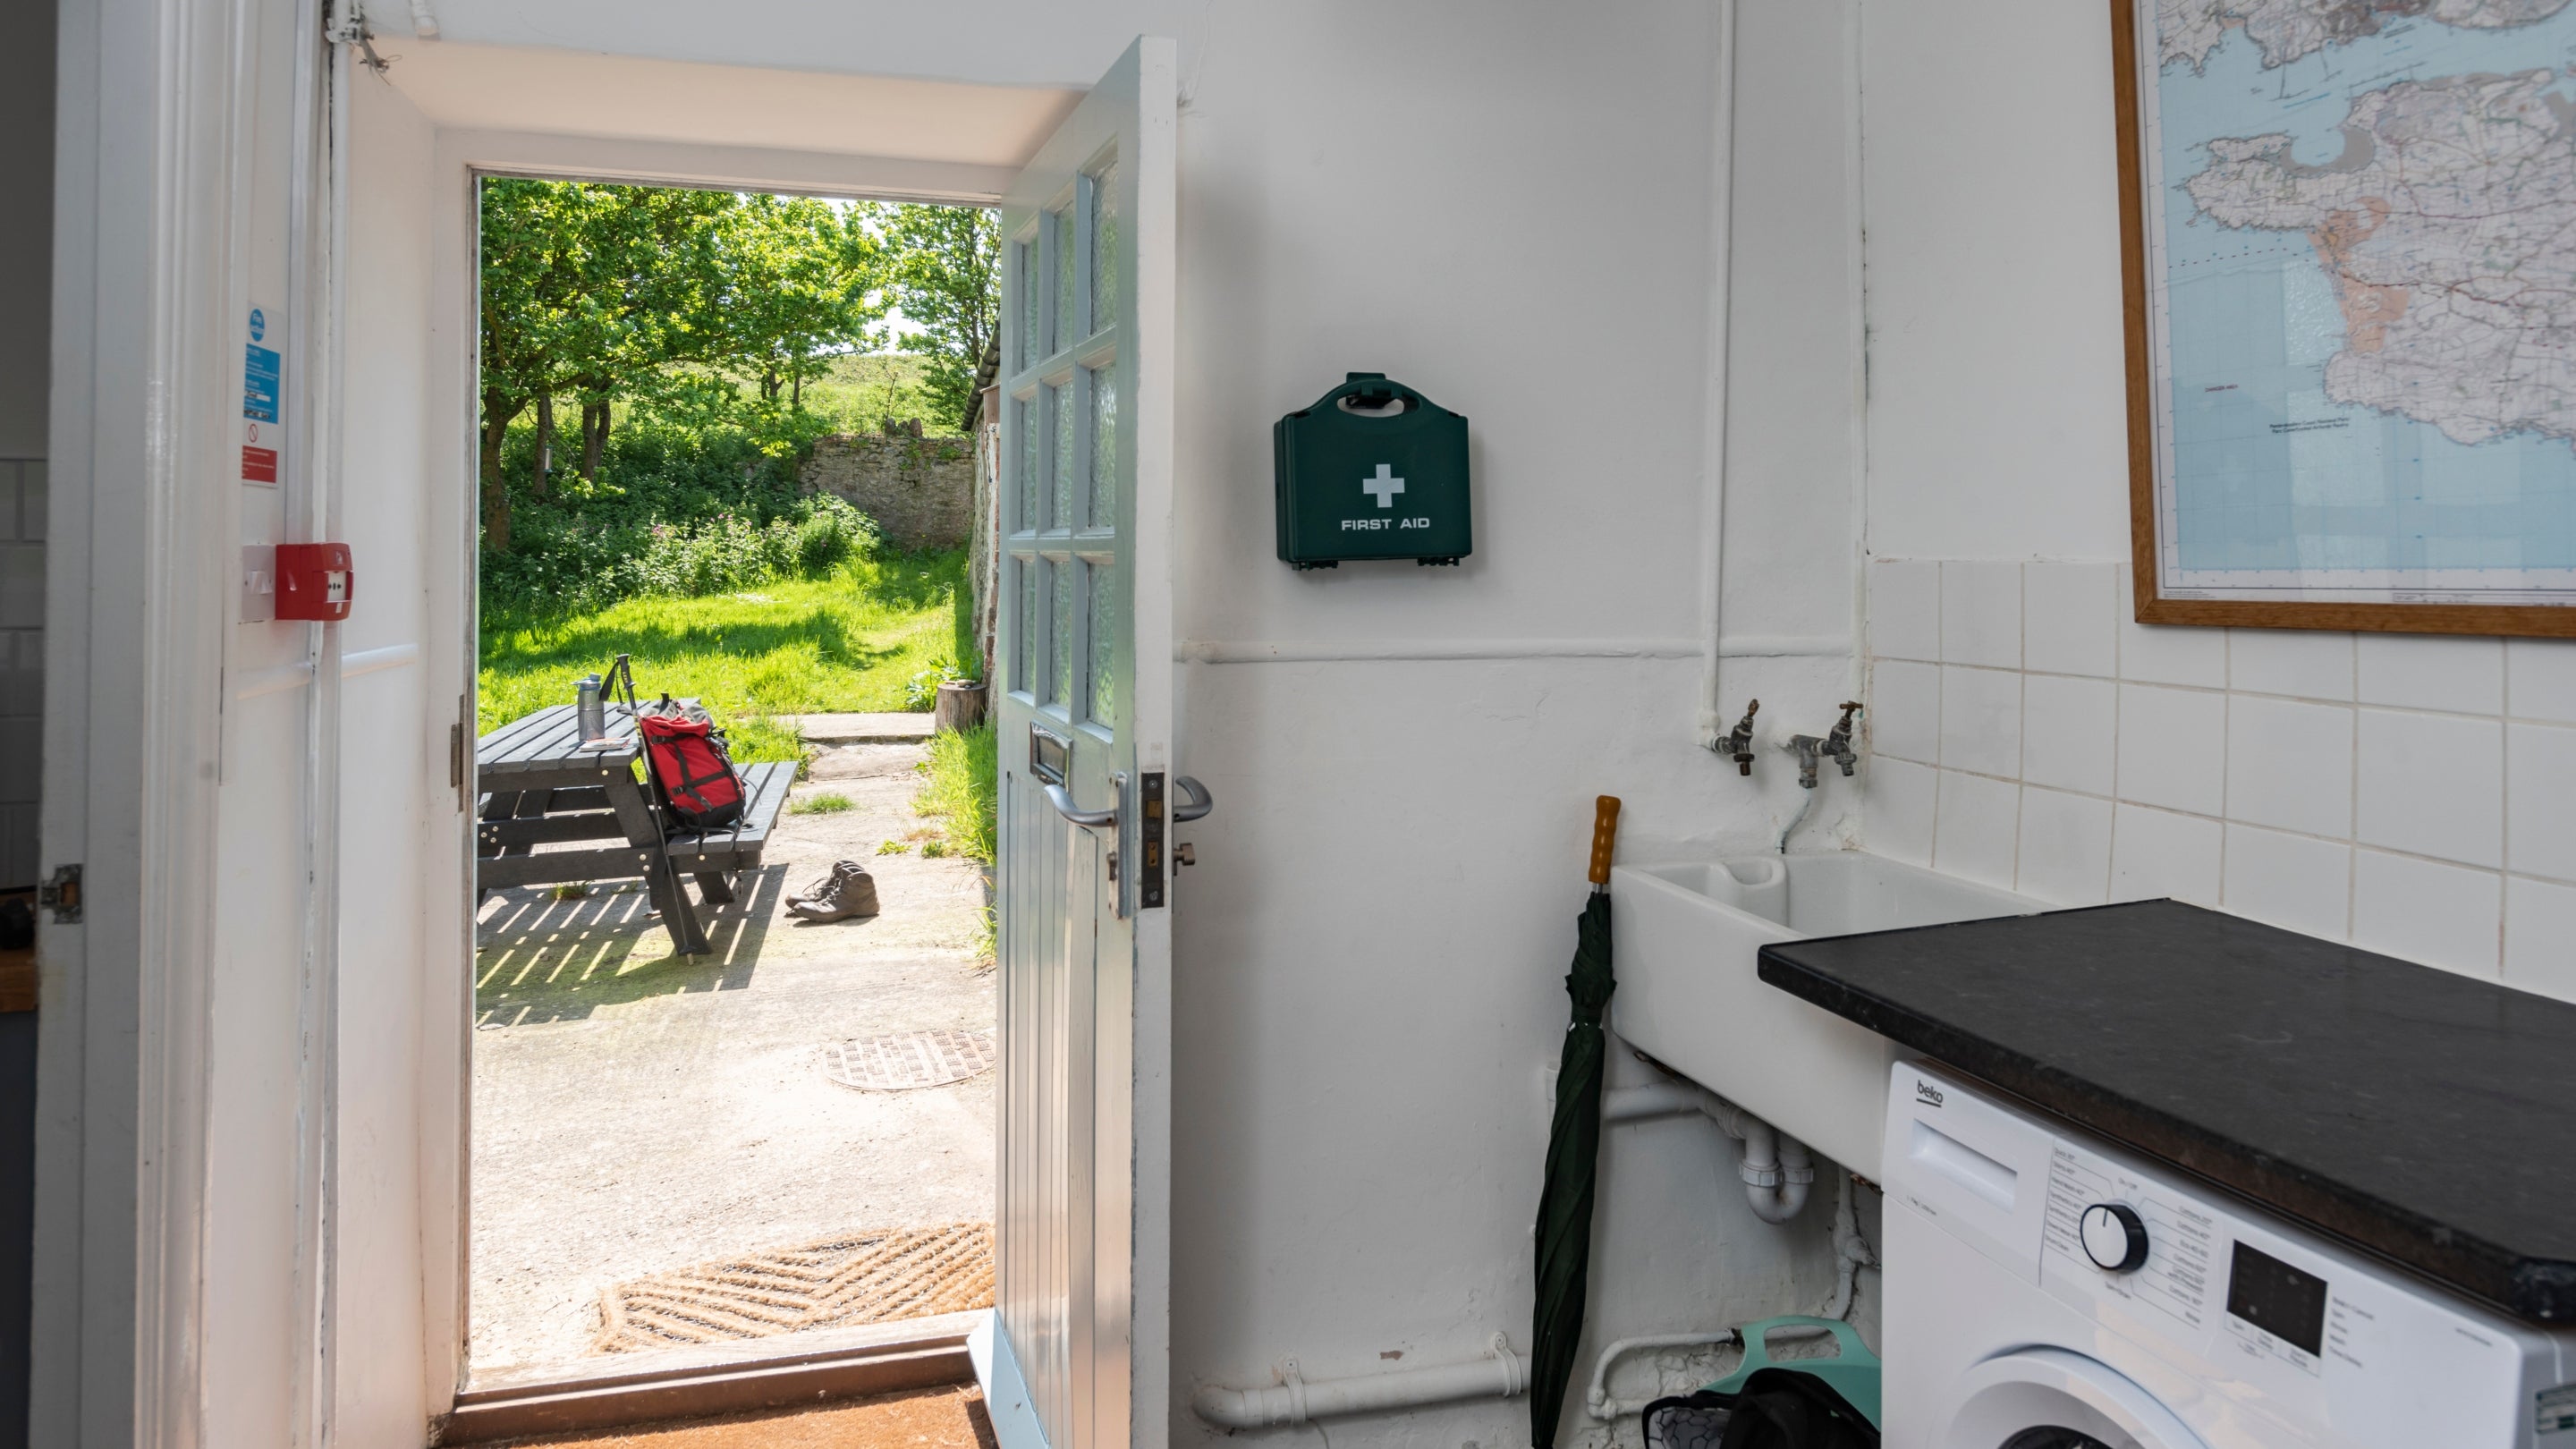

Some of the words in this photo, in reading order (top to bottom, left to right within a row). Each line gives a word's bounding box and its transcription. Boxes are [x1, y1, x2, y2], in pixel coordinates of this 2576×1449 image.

[1341, 519, 1392, 530] FIRST
[1400, 518, 1430, 529] AID
[1917, 1080, 1944, 1103] beko
